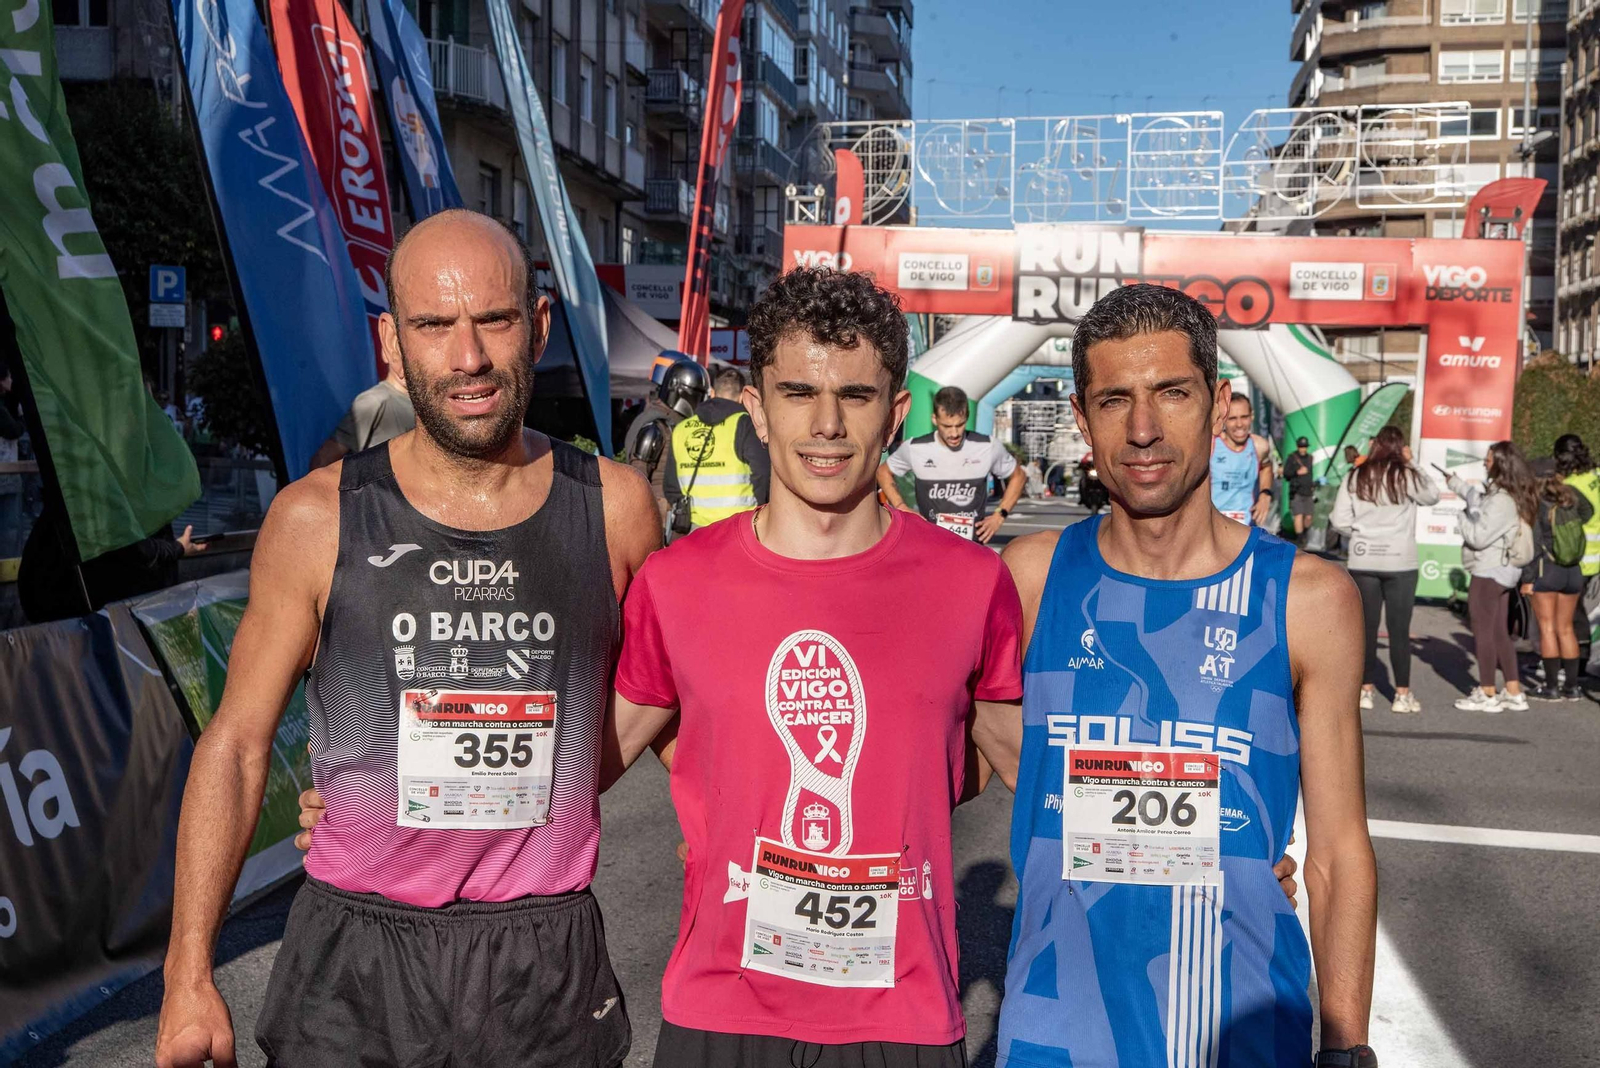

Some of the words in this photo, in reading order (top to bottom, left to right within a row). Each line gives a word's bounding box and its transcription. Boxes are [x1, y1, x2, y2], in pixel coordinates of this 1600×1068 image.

[326, 39, 386, 235] EROSKI
[1020, 230, 1140, 275] RUN
[904, 259, 963, 270] CONCELLO
[157, 270, 178, 297] P
[910, 272, 925, 281] DE
[929, 273, 955, 281] VIGO
[1295, 270, 1357, 280] CONCELLO
[1422, 264, 1487, 288] VIGO
[631, 284, 674, 292] CONCELLO
[1302, 282, 1318, 291] DE
[1321, 282, 1350, 291] VIGO
[1425, 286, 1513, 303] DEPORTE
[650, 292, 669, 300] VIGO
[1439, 353, 1502, 369] amura
[928, 482, 977, 499] delikia
[429, 559, 520, 585] CUPA
[454, 586, 515, 601] PIZARRAS
[392, 612, 417, 643] O
[430, 611, 556, 642] BARCO
[792, 644, 827, 667] VI
[1067, 656, 1105, 670] AIMAR
[781, 666, 841, 681] EDICIÓN
[780, 679, 848, 700] VIGO
[778, 700, 833, 711] CONTRA
[836, 699, 855, 709] EL
[452, 720, 484, 728] marcha
[783, 709, 853, 726] CÁNCER
[453, 732, 533, 769] 355
[1082, 776, 1100, 786] Vigo
[1111, 777, 1140, 785] marcha
[1141, 779, 1168, 787] contra
[1176, 780, 1205, 788] cancro
[1111, 789, 1197, 828] 206
[768, 868, 785, 880] Vigo
[795, 877, 825, 890] marcha
[826, 883, 853, 891] contra
[860, 883, 888, 891] cancro
[794, 890, 878, 929] 452
